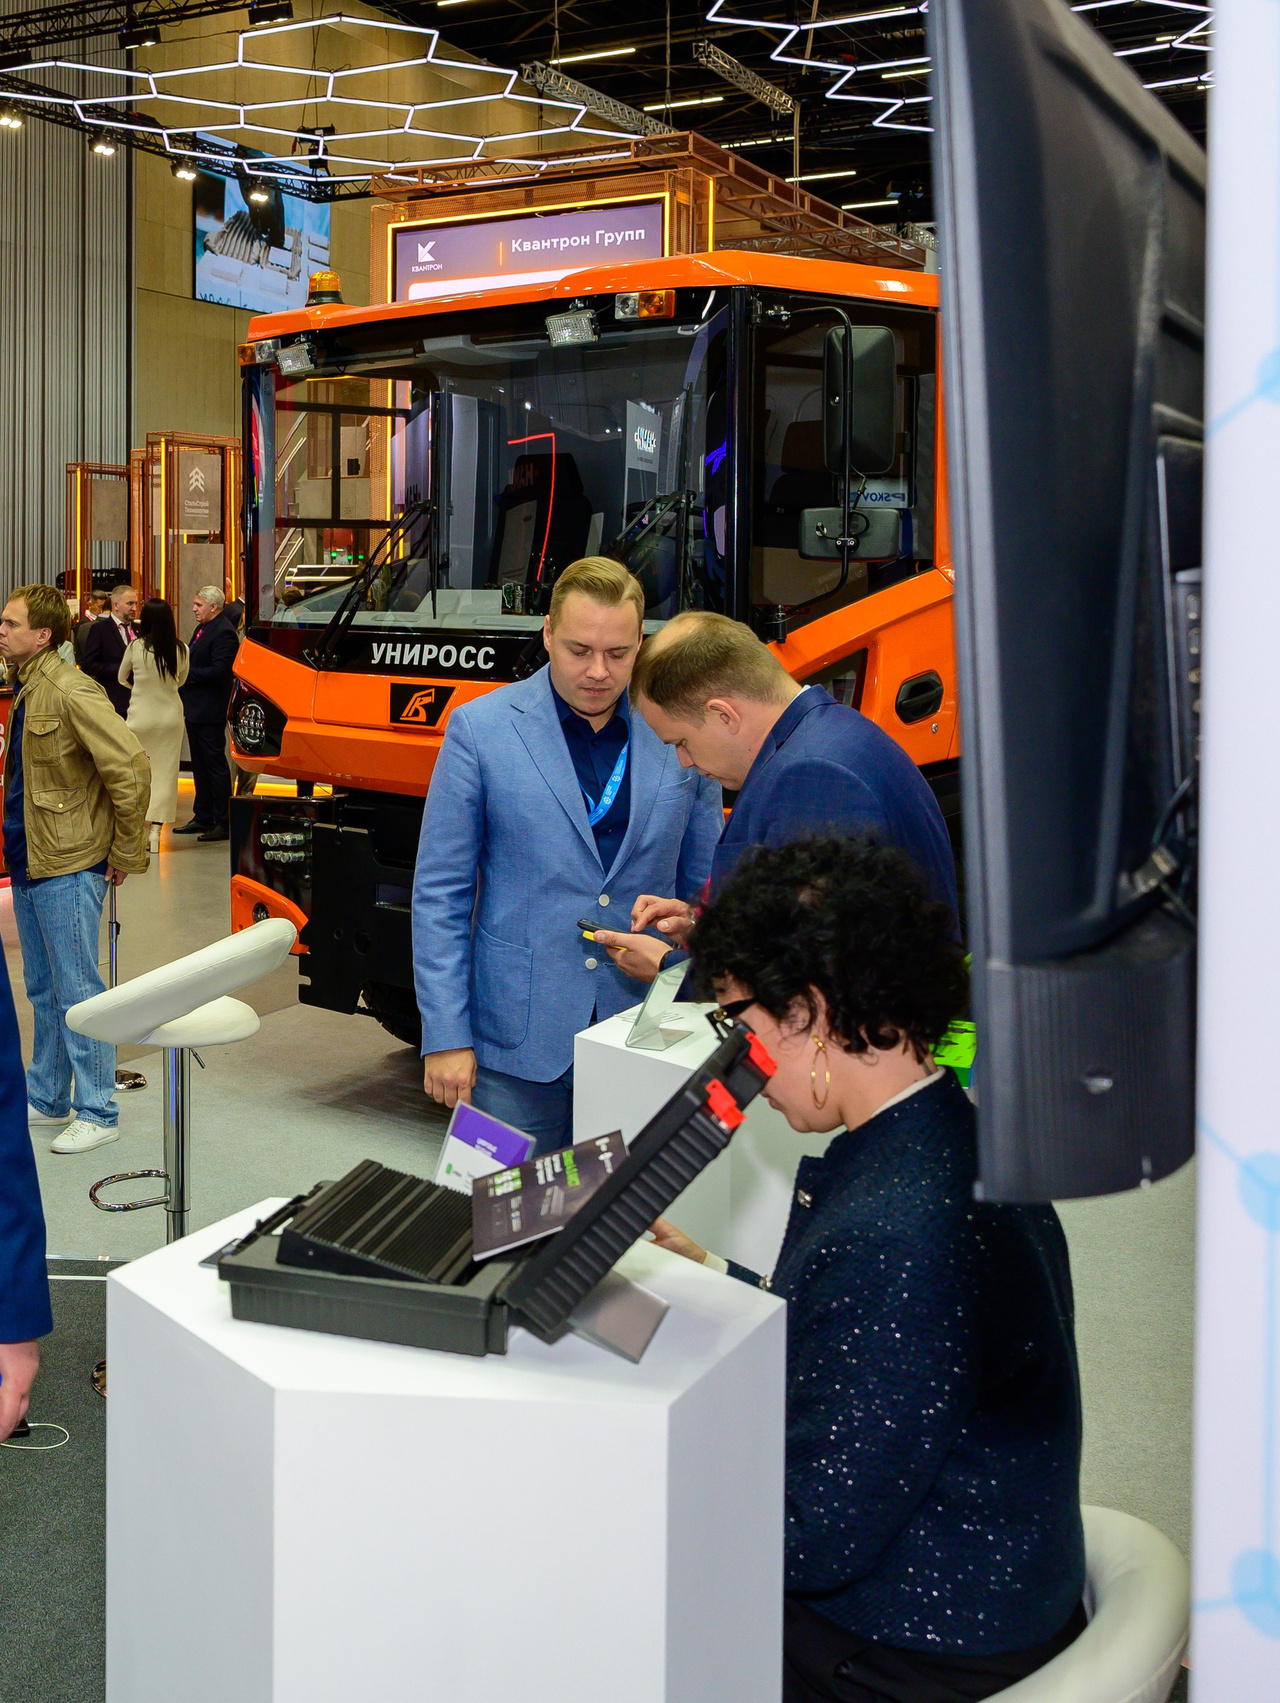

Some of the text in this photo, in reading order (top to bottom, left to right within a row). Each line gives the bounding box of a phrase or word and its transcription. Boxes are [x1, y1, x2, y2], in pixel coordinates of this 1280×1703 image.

[511, 228, 646, 253] Квантрон Групп
[411, 262, 443, 273] КВАНТРОН
[371, 642, 496, 670] УНИРОСС
